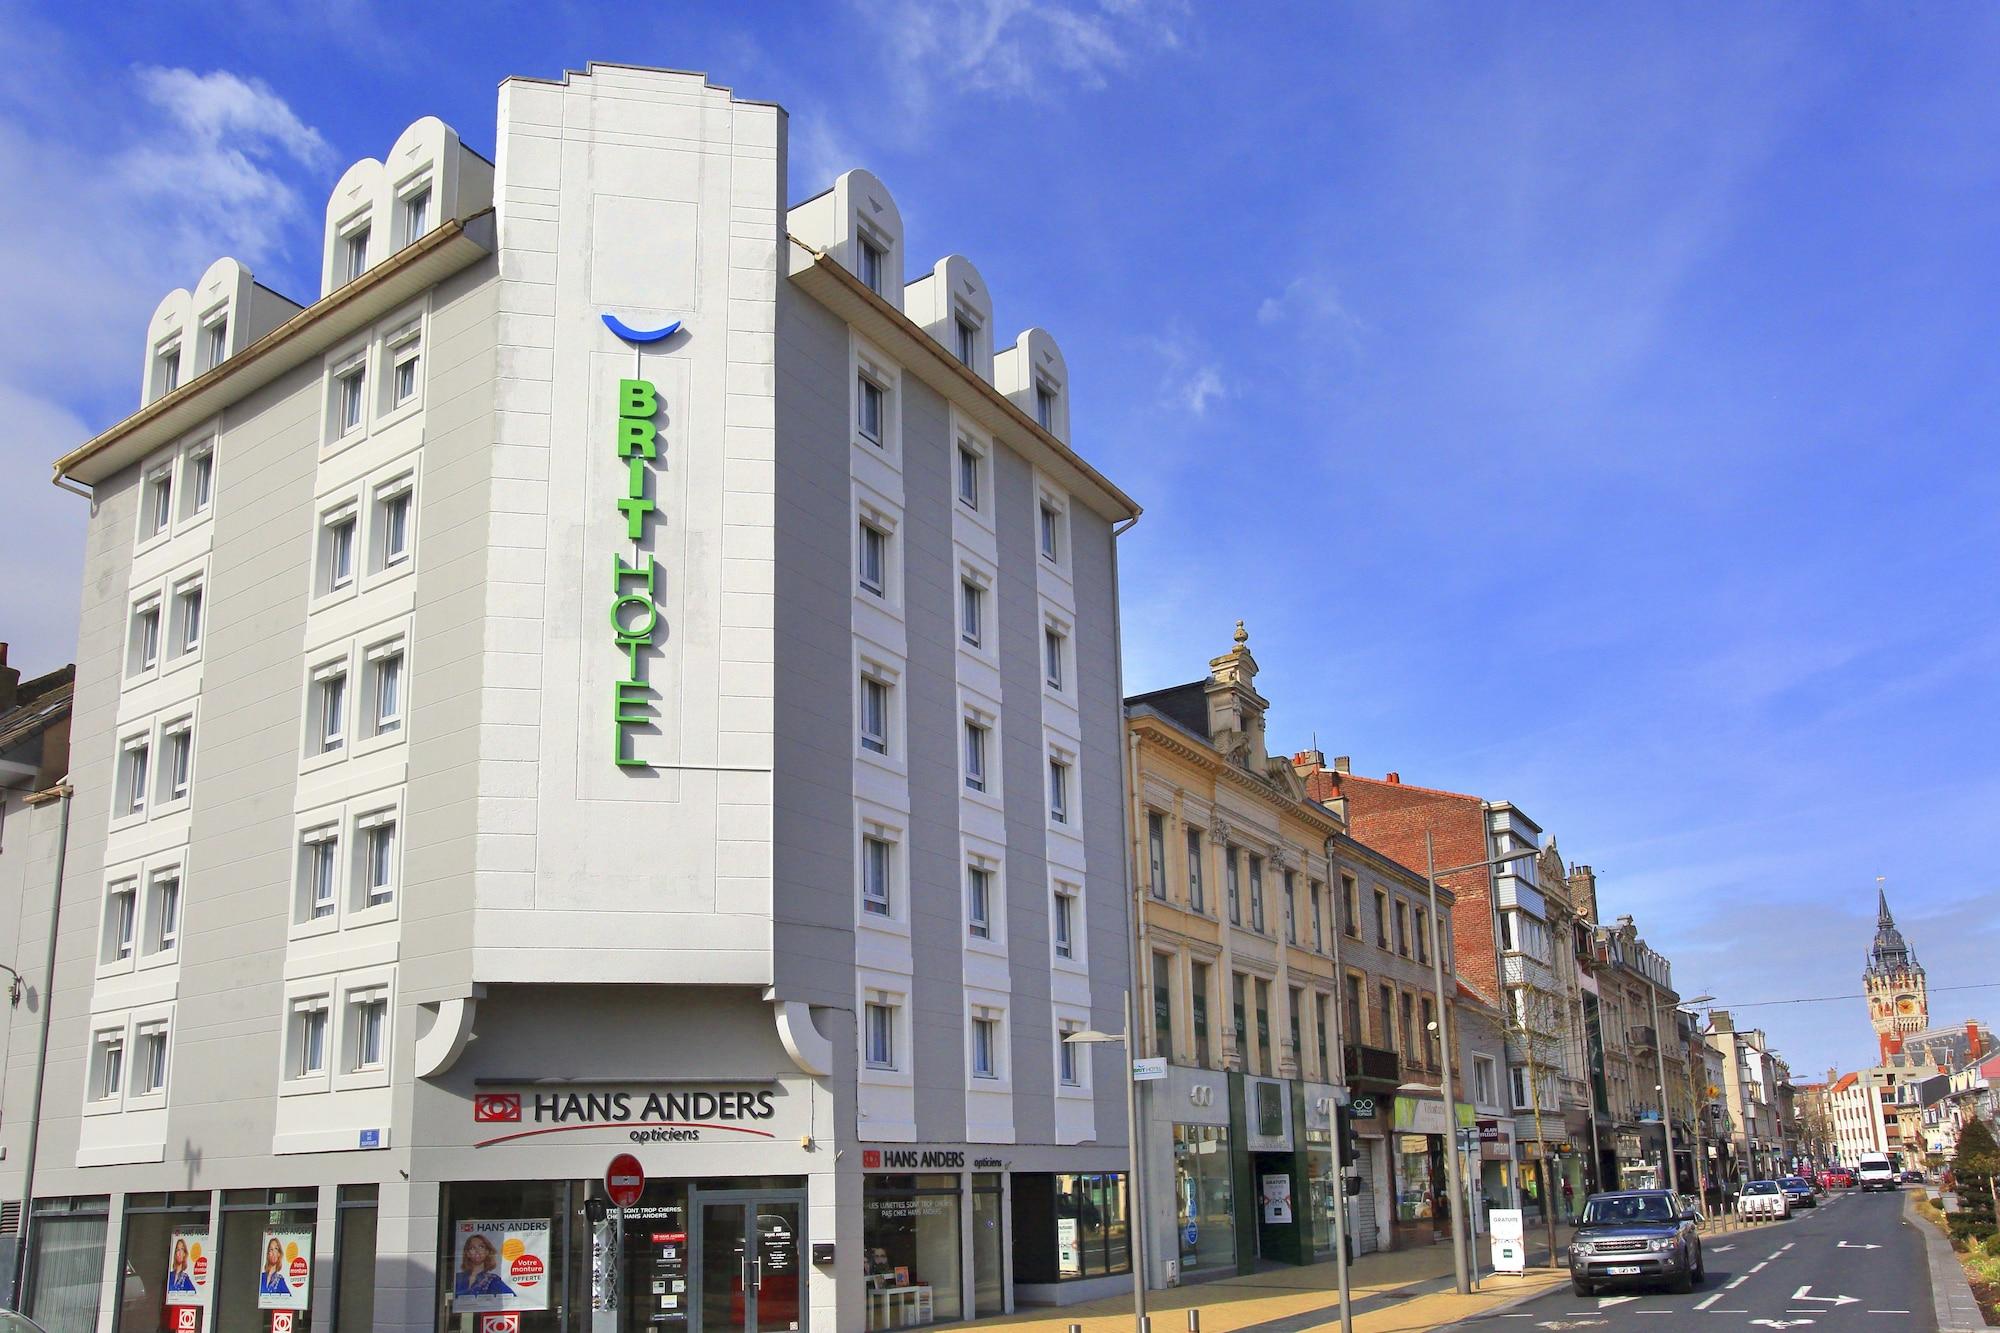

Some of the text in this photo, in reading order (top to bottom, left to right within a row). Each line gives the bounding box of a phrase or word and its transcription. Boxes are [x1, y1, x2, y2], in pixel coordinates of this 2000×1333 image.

[617, 378, 658, 539] BRIT
[610, 553, 657, 767] HOTEL
[534, 1090, 775, 1123] HANS ANDERS
[629, 1127, 700, 1145] opticiens
[883, 1150, 1002, 1169] HANS ANDERS opticiens
[476, 1221, 548, 1232] HANS ANDERS
[517, 1259, 538, 1267] Votre
